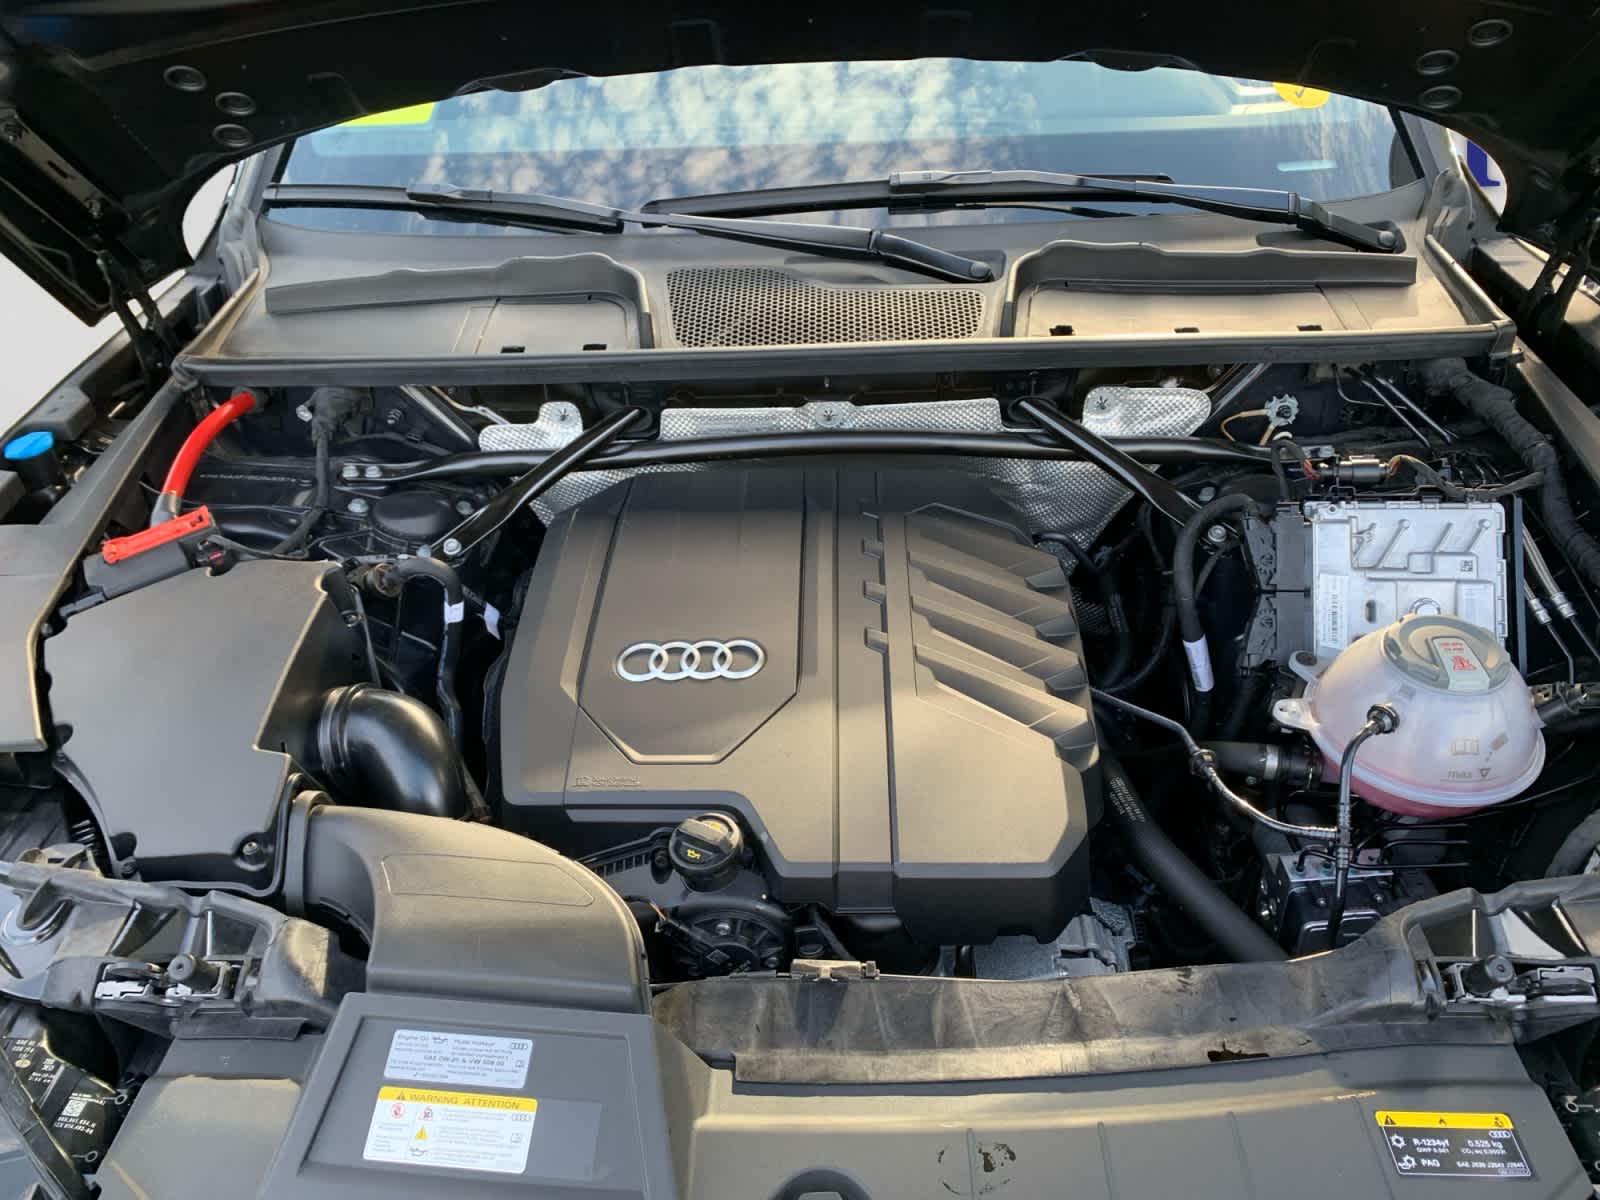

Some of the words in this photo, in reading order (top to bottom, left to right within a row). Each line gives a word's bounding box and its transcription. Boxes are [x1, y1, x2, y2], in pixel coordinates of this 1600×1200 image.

[408, 1093, 459, 1105] WARNING
[463, 1098, 521, 1110] ATTENTION
[1420, 1158, 1441, 1168] PAG
